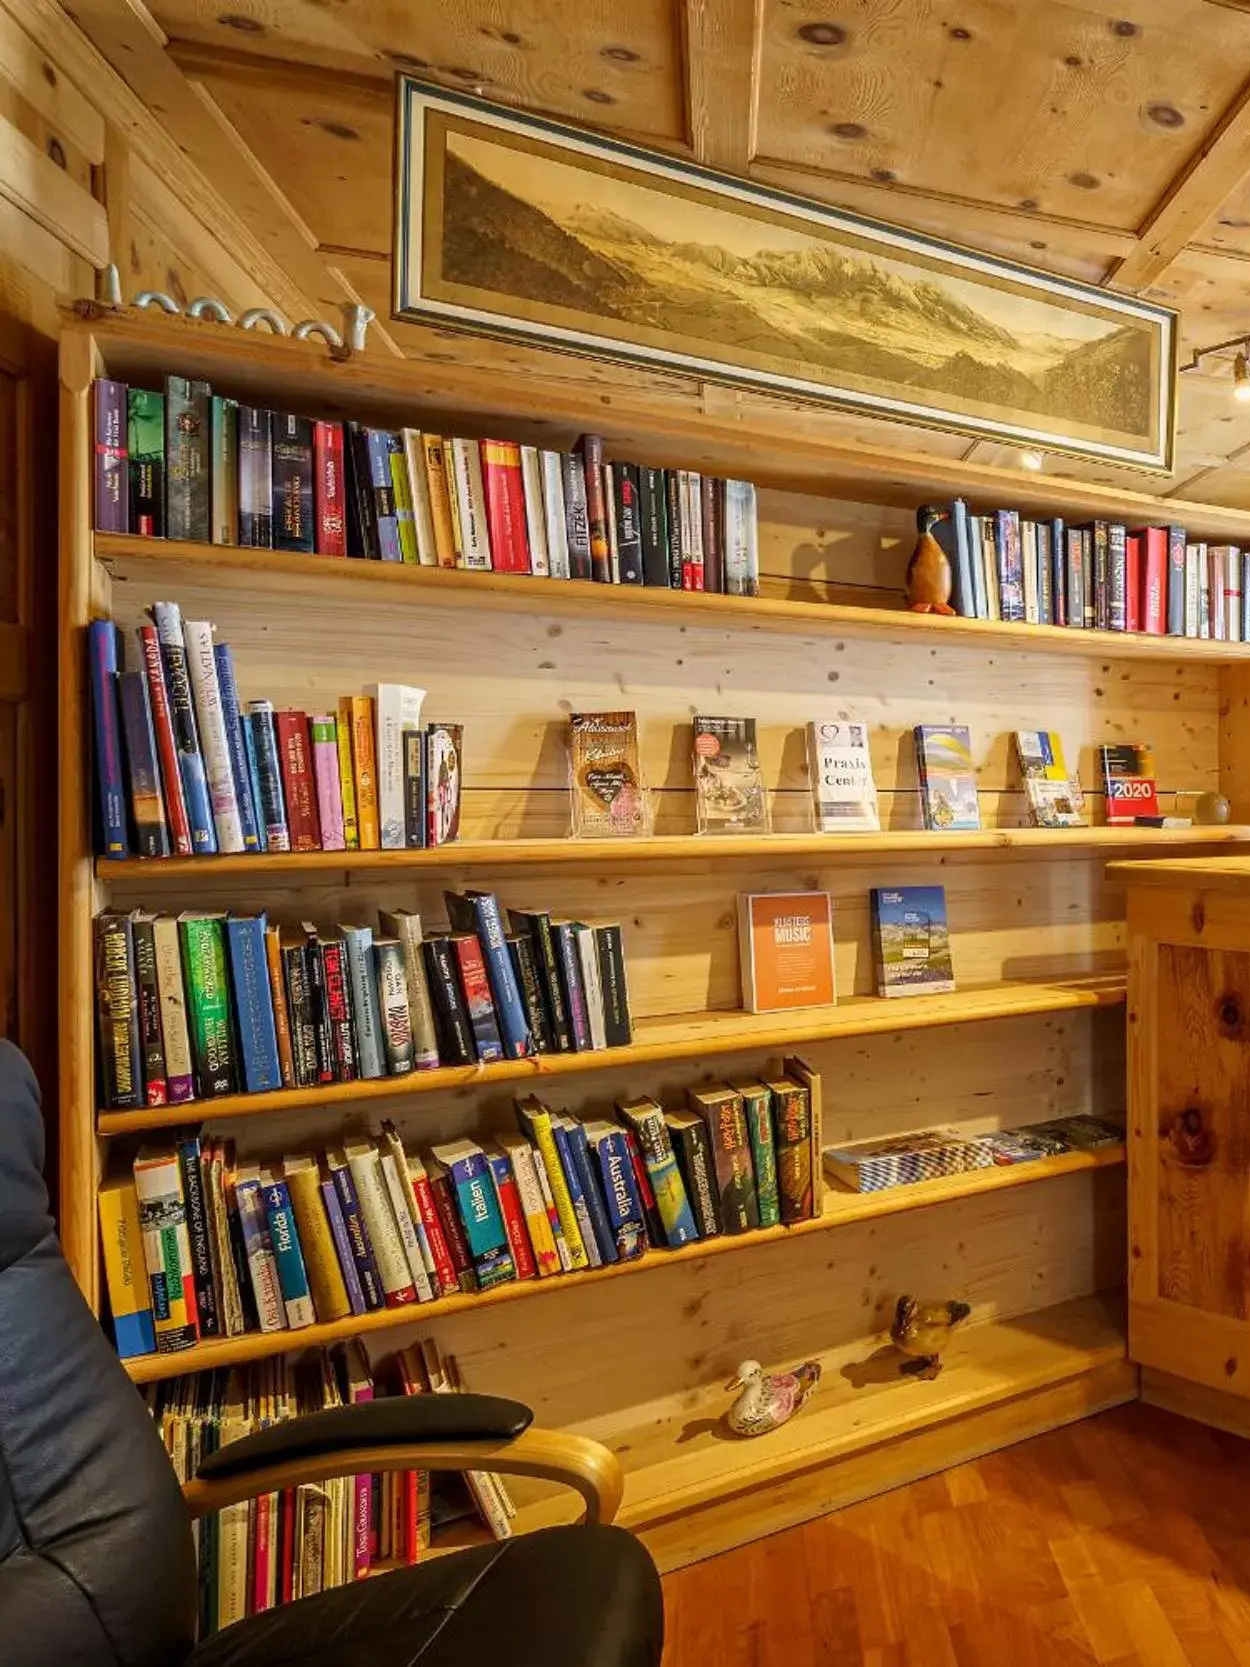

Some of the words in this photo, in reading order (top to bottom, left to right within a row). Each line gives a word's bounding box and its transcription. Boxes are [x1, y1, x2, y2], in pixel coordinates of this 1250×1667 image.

[574, 505, 590, 548] FITZEK
[144, 636, 165, 683] KANADA
[824, 757, 867, 770] Praxis
[1114, 783, 1152, 799] 2020
[105, 933, 127, 968] ROBERT
[774, 928, 812, 944] MUSIC
[107, 971, 131, 1018] LUDLUM
[217, 1017, 229, 1067] WILLIAM
[475, 1181, 491, 1223] Italien
[608, 1155, 630, 1218] Australia
[190, 1174, 203, 1219] BACKBONE
[198, 1234, 208, 1275] ENGLAND
[278, 1211, 293, 1252] Florida
